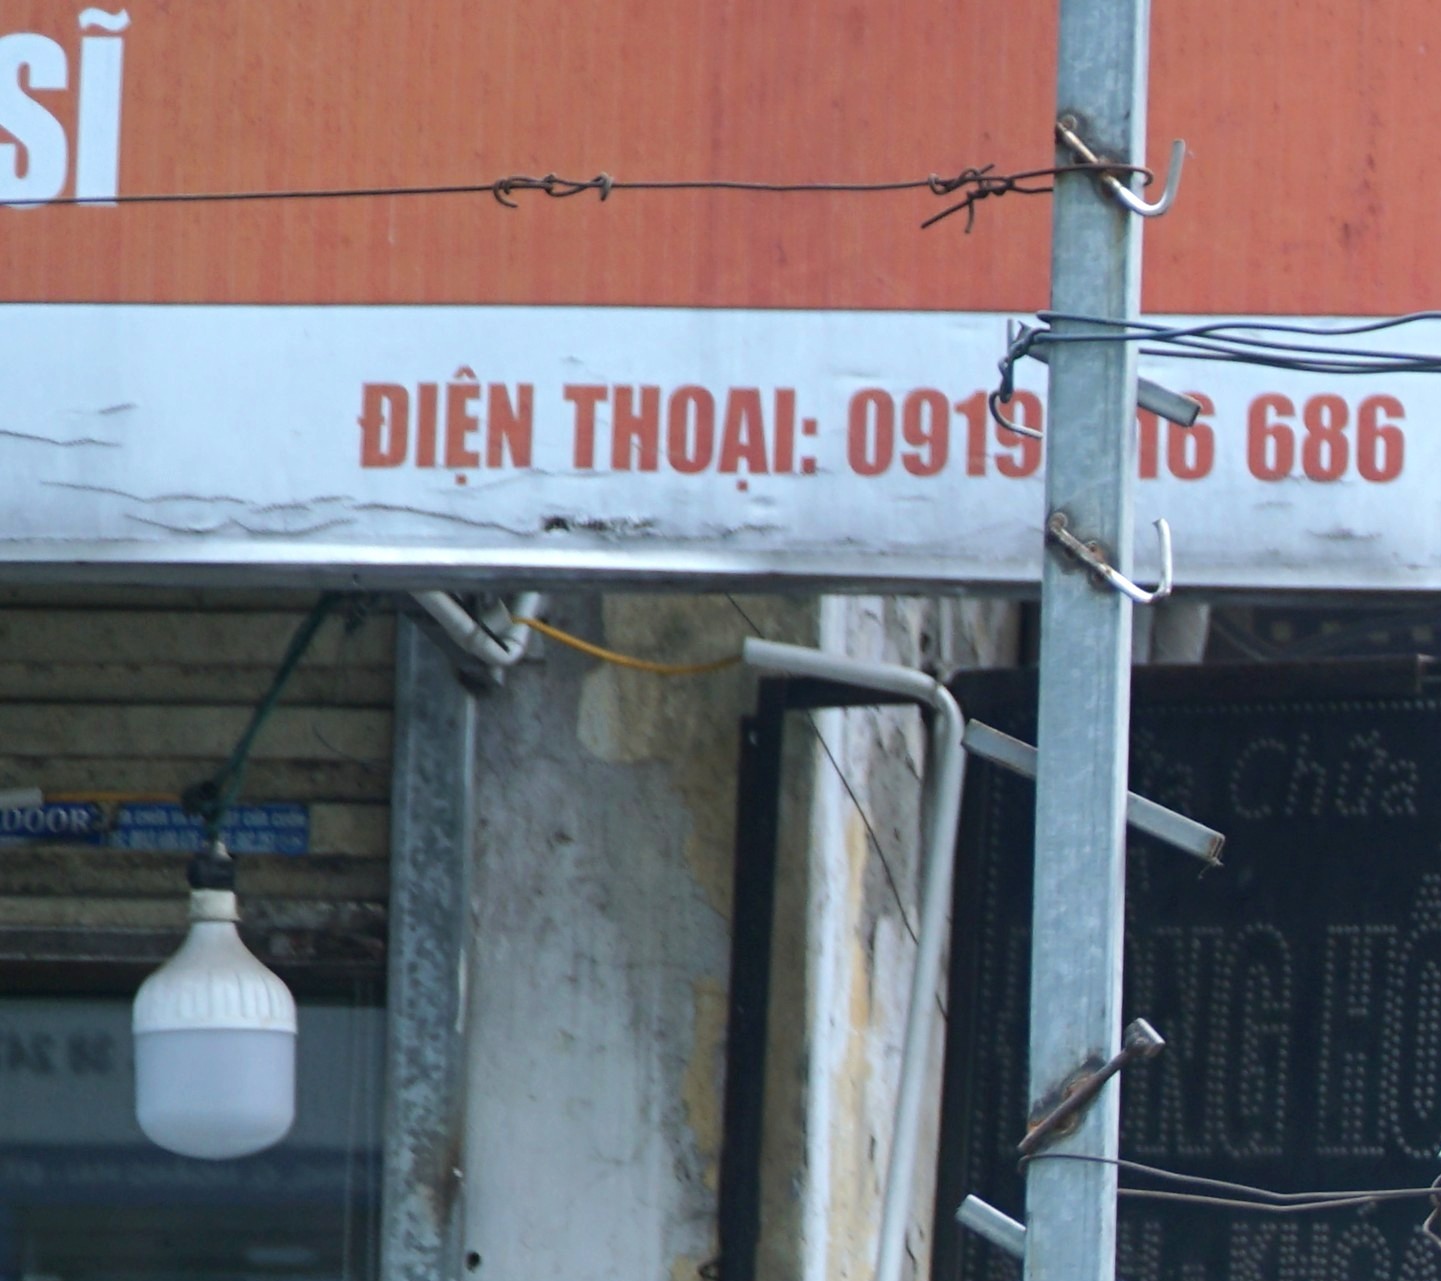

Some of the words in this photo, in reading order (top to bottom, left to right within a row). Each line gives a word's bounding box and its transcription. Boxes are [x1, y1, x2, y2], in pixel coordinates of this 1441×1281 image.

[358, 365, 534, 488] ĐIỆN
[569, 380, 819, 492] THOẠI:
[847, 387, 1044, 480] 0919
[1246, 391, 1407, 483] 686
